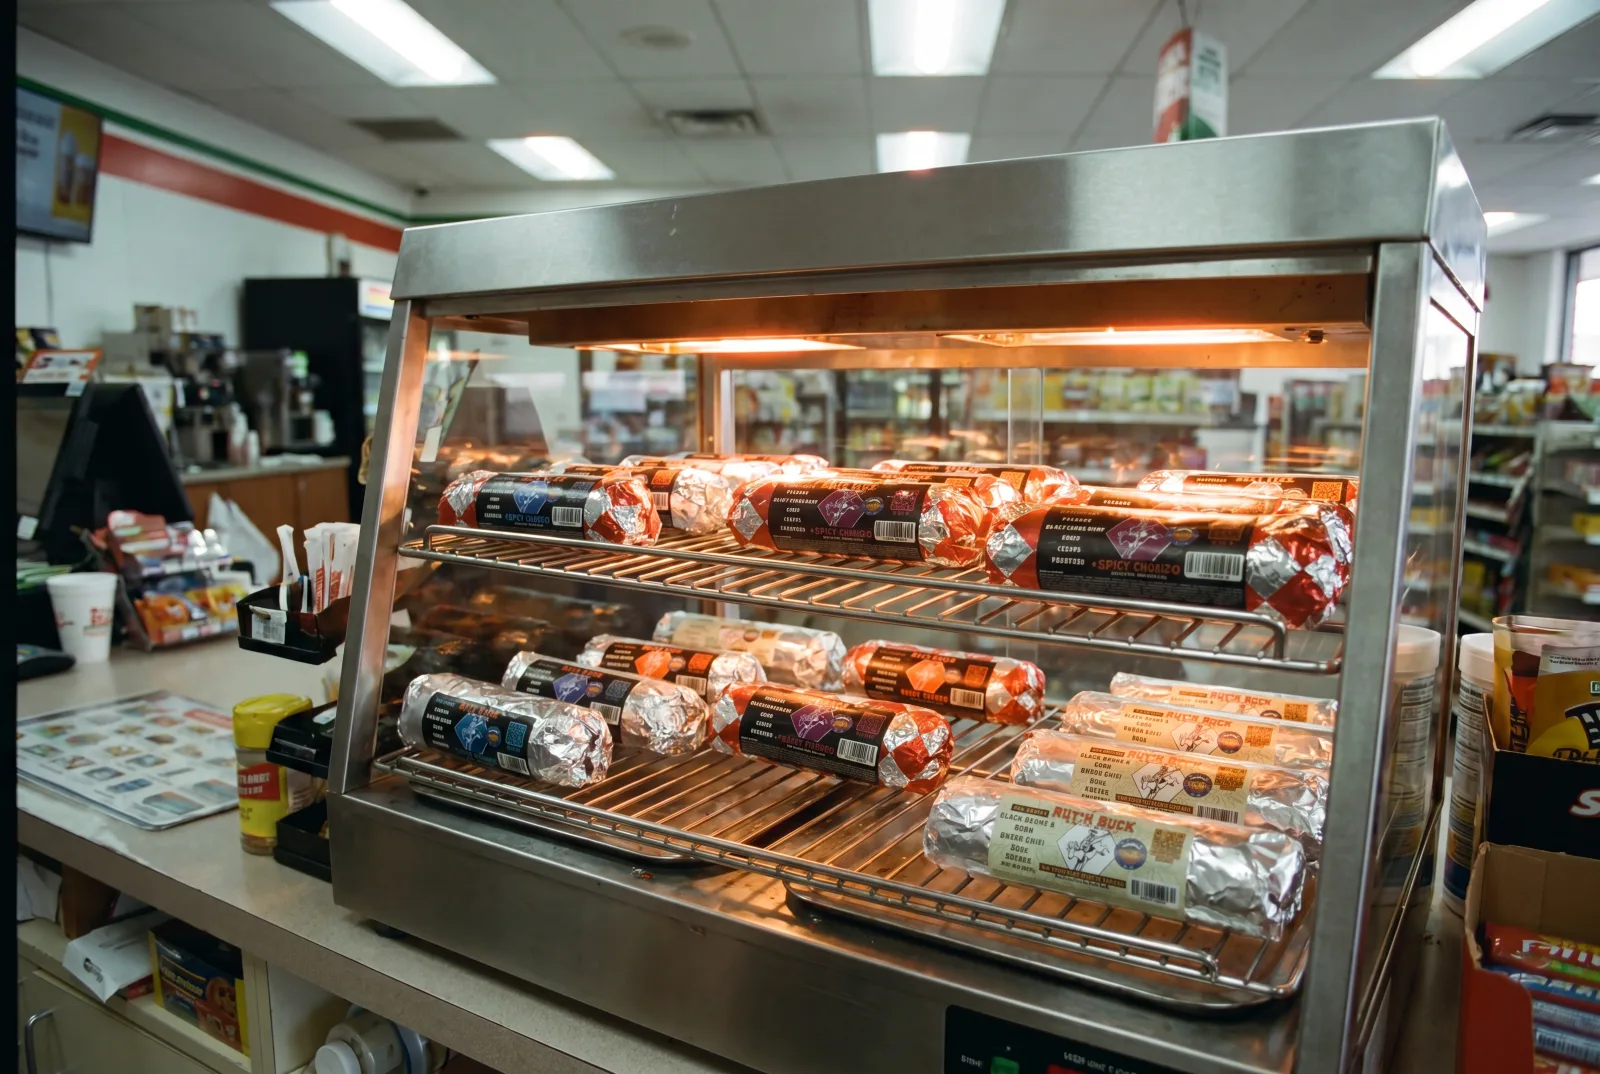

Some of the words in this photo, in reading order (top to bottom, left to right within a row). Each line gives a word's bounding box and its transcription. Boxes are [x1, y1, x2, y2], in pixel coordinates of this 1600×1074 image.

[814, 526, 837, 536] SPICY
[1098, 559, 1129, 571] SPICY
[1097, 815, 1136, 833] BUCK
